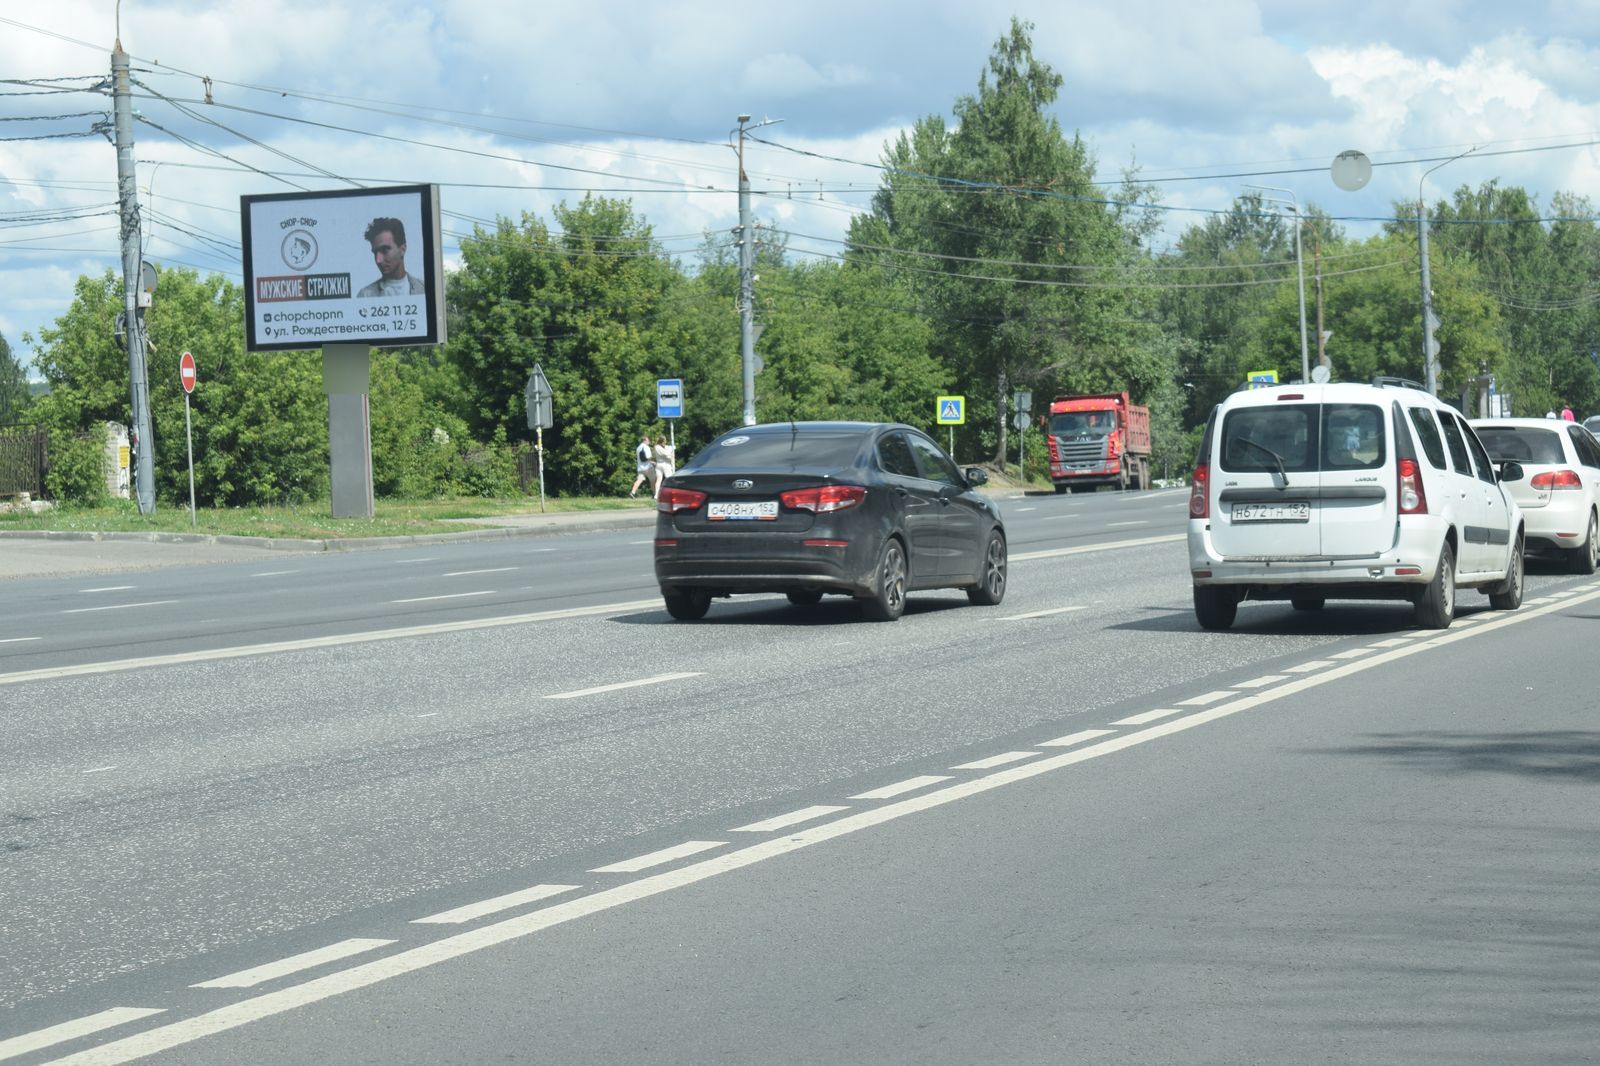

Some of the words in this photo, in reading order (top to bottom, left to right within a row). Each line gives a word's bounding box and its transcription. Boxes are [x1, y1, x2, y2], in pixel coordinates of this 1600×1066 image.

[280, 217, 317, 229] CHOP-CHOP
[260, 279, 303, 299] МУЖСКИЕ
[307, 276, 349, 297] СТРИЖКИ
[274, 310, 344, 324] chopchopnn
[371, 306, 390, 317] 262
[392, 305, 402, 316] 11
[404, 304, 418, 315] 22
[273, 328, 289, 339] ул.
[292, 322, 389, 336] Рождественская,
[392, 319, 417, 332] 12/5
[1288, 503, 1306, 514] 152
